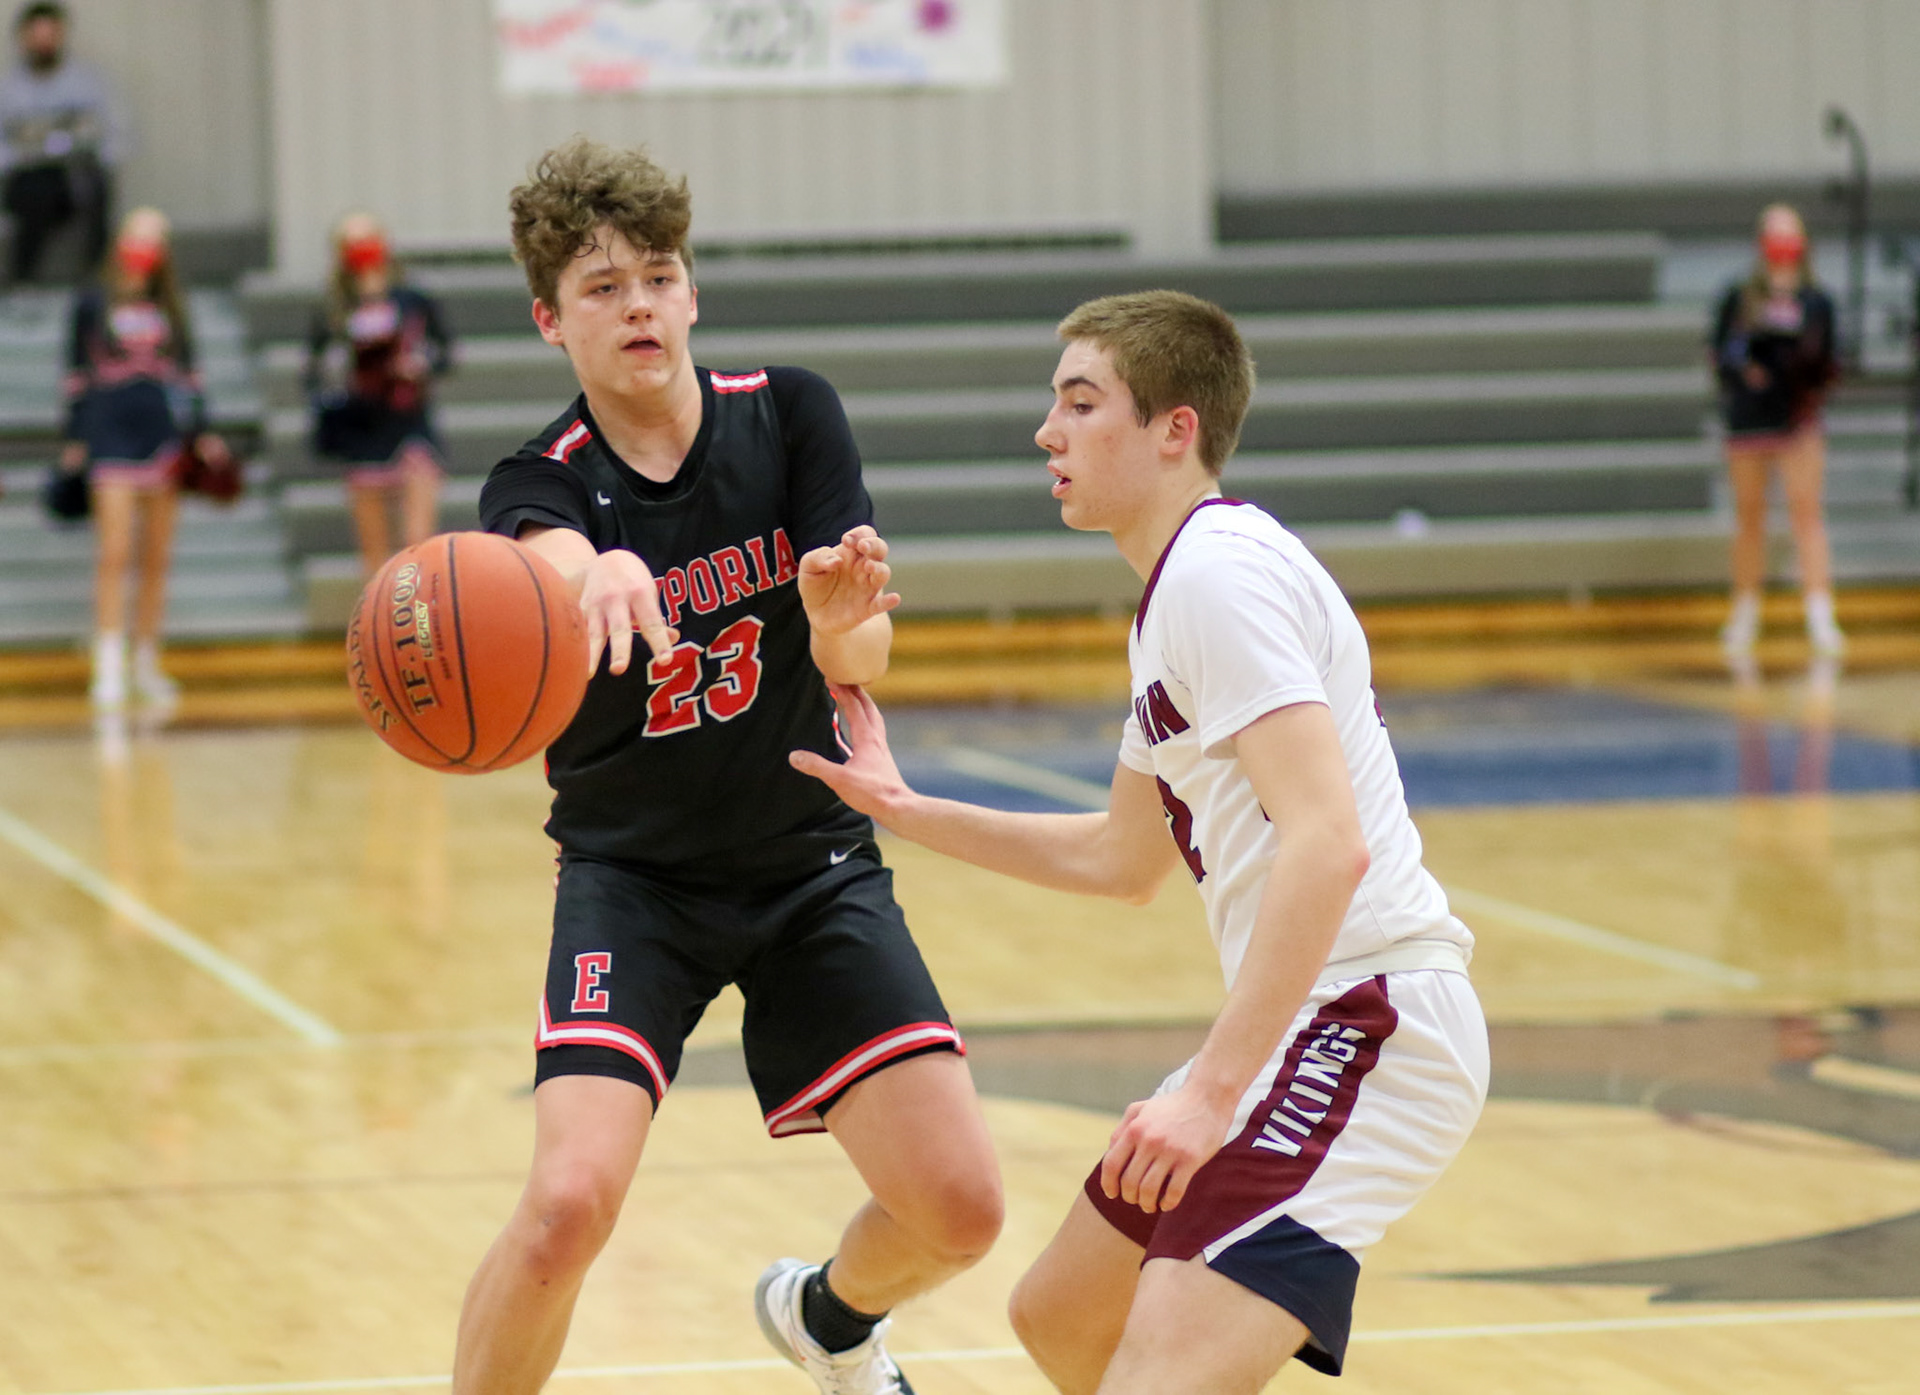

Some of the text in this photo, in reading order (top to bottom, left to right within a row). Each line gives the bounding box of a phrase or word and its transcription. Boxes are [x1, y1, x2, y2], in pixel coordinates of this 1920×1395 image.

[414, 600, 434, 659] LEGACY
[630, 527, 799, 633] PORIA
[641, 614, 765, 738] 23
[570, 951, 612, 1014] E
[1250, 1021, 1367, 1158] VIKINGS
